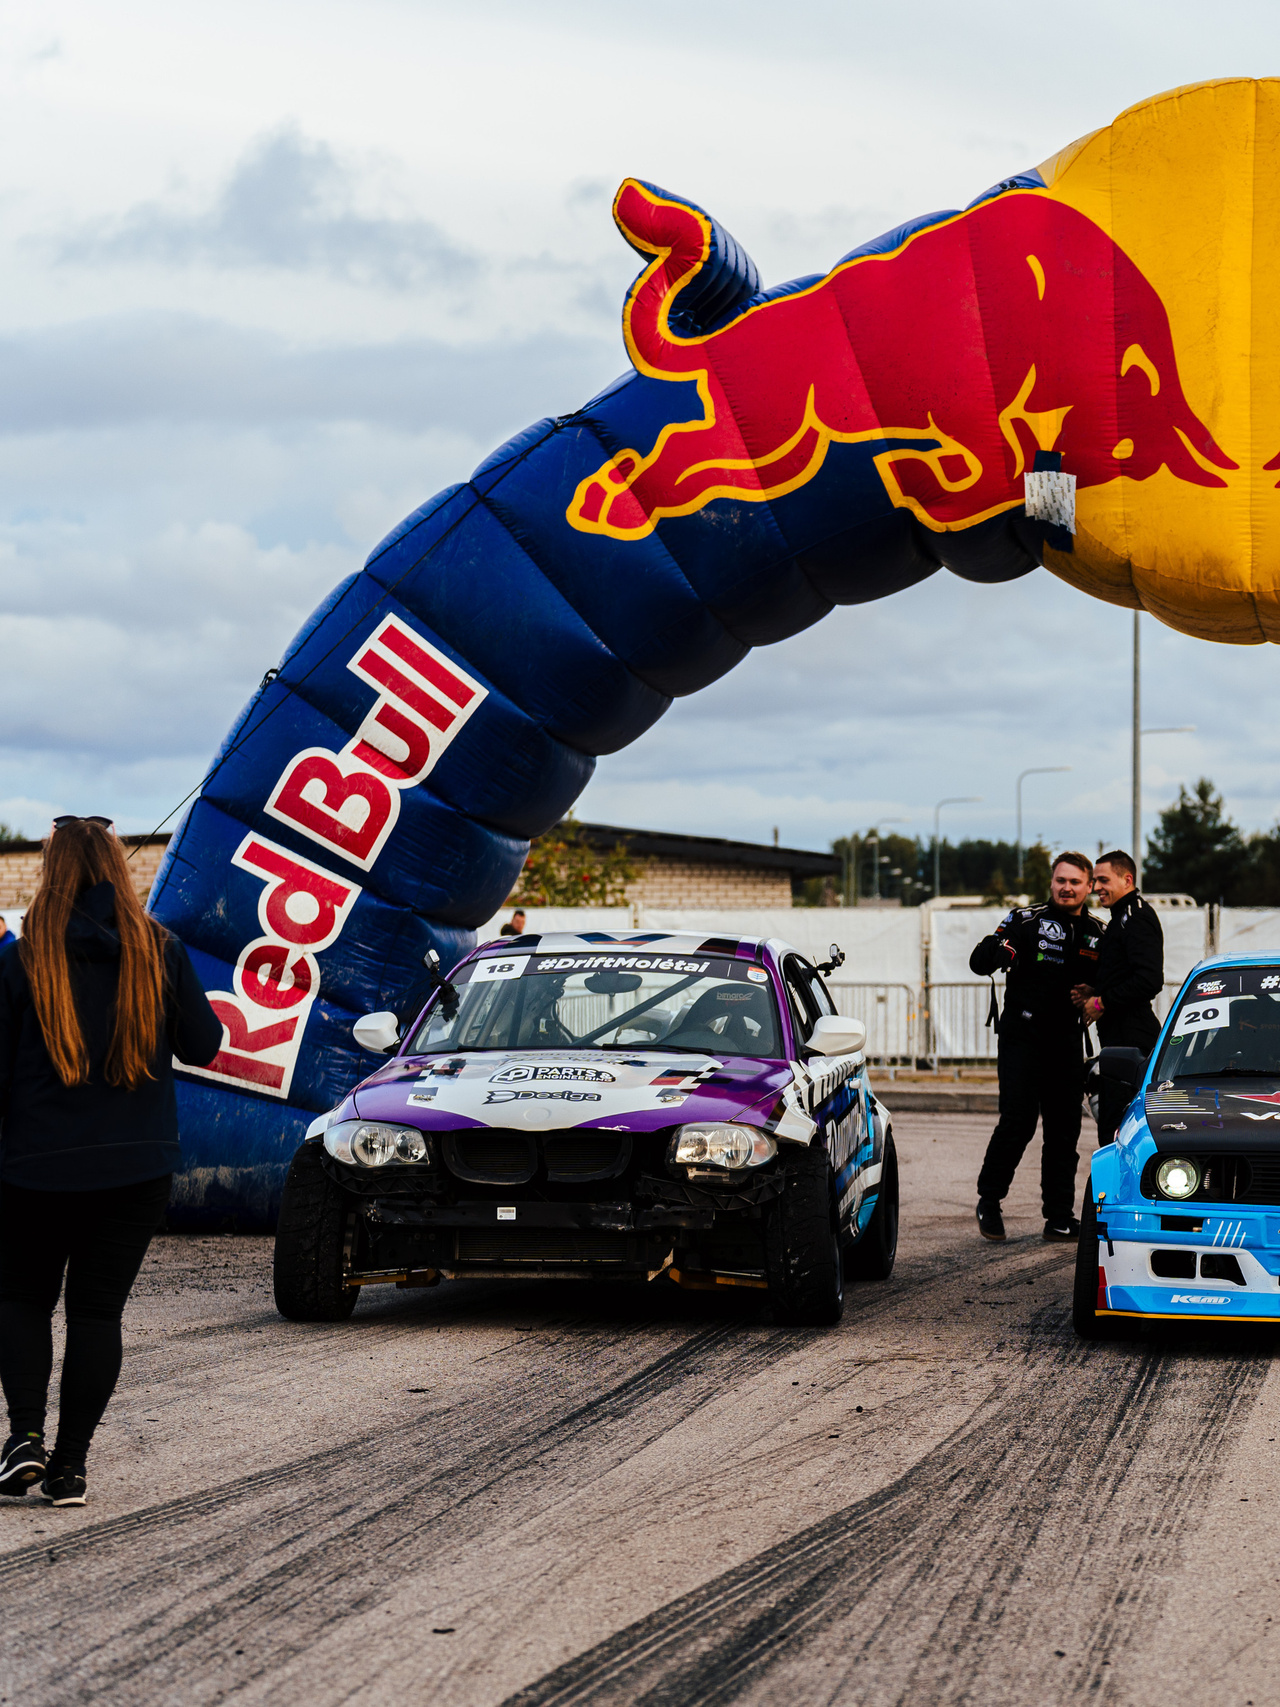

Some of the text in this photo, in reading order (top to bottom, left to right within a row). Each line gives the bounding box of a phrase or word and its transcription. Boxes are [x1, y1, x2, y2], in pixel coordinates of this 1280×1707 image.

[190, 620, 480, 1092] Red Bull
[486, 963, 516, 974] 18
[1184, 1008, 1219, 1026] 20
[537, 1067, 595, 1077] PARTS
